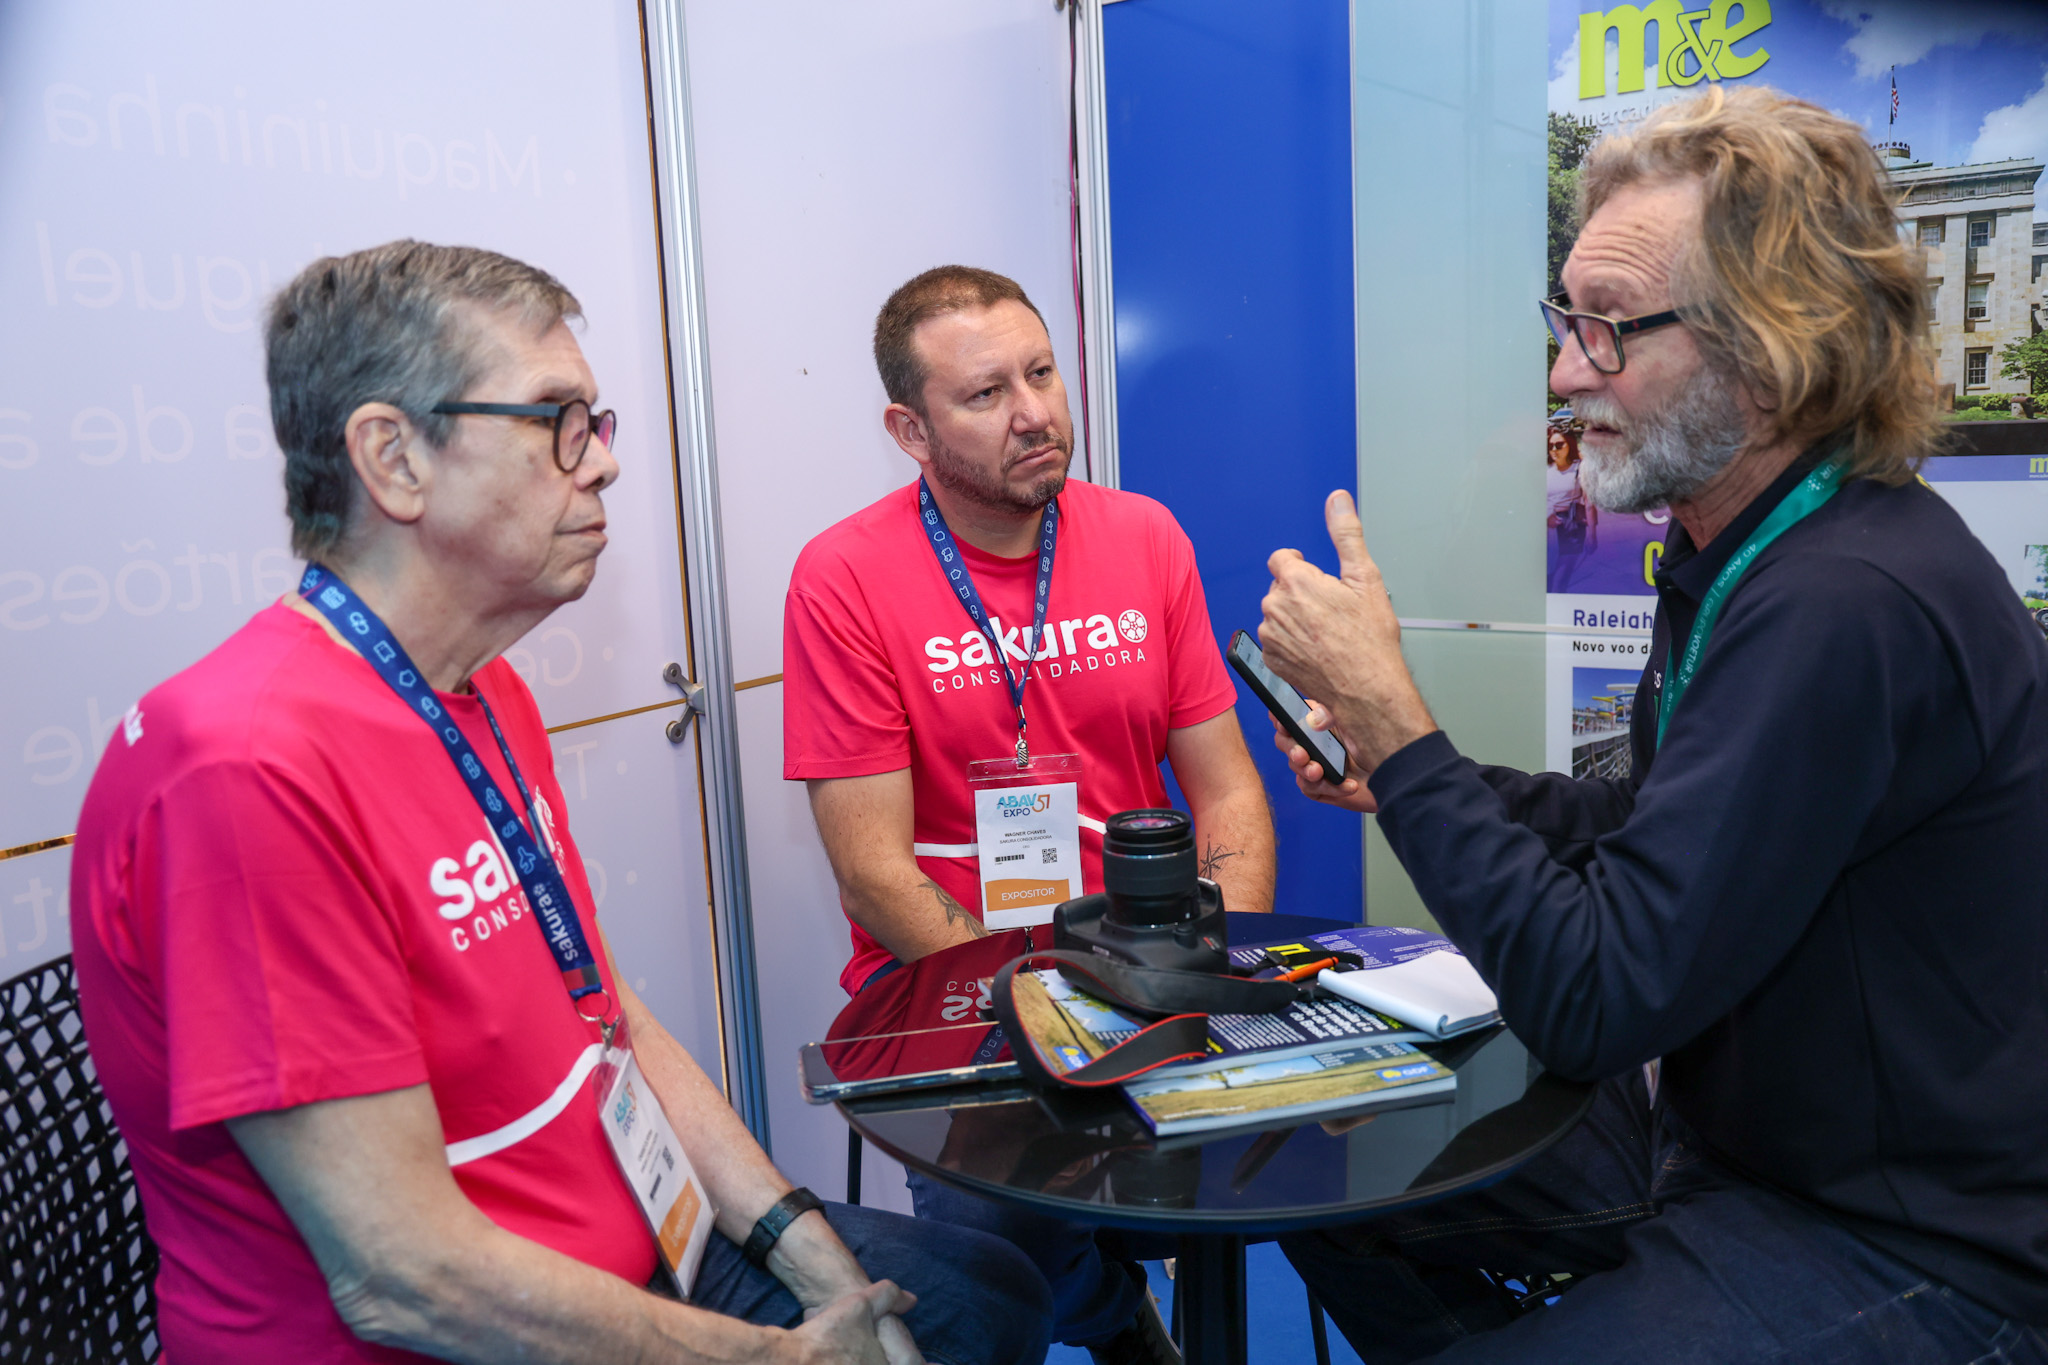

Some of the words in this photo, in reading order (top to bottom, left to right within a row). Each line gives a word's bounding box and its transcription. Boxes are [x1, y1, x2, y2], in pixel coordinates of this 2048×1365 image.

[1573, 609, 1653, 629] Raleigh
[924, 614, 1120, 673] sakura
[1573, 641, 1605, 653] Novo
[1611, 644, 1635, 654] voo
[996, 793, 1037, 810] ABAV
[1003, 807, 1031, 818] EXPO
[1001, 887, 1056, 901] EXPOSITOR
[538, 891, 580, 962] sakura
